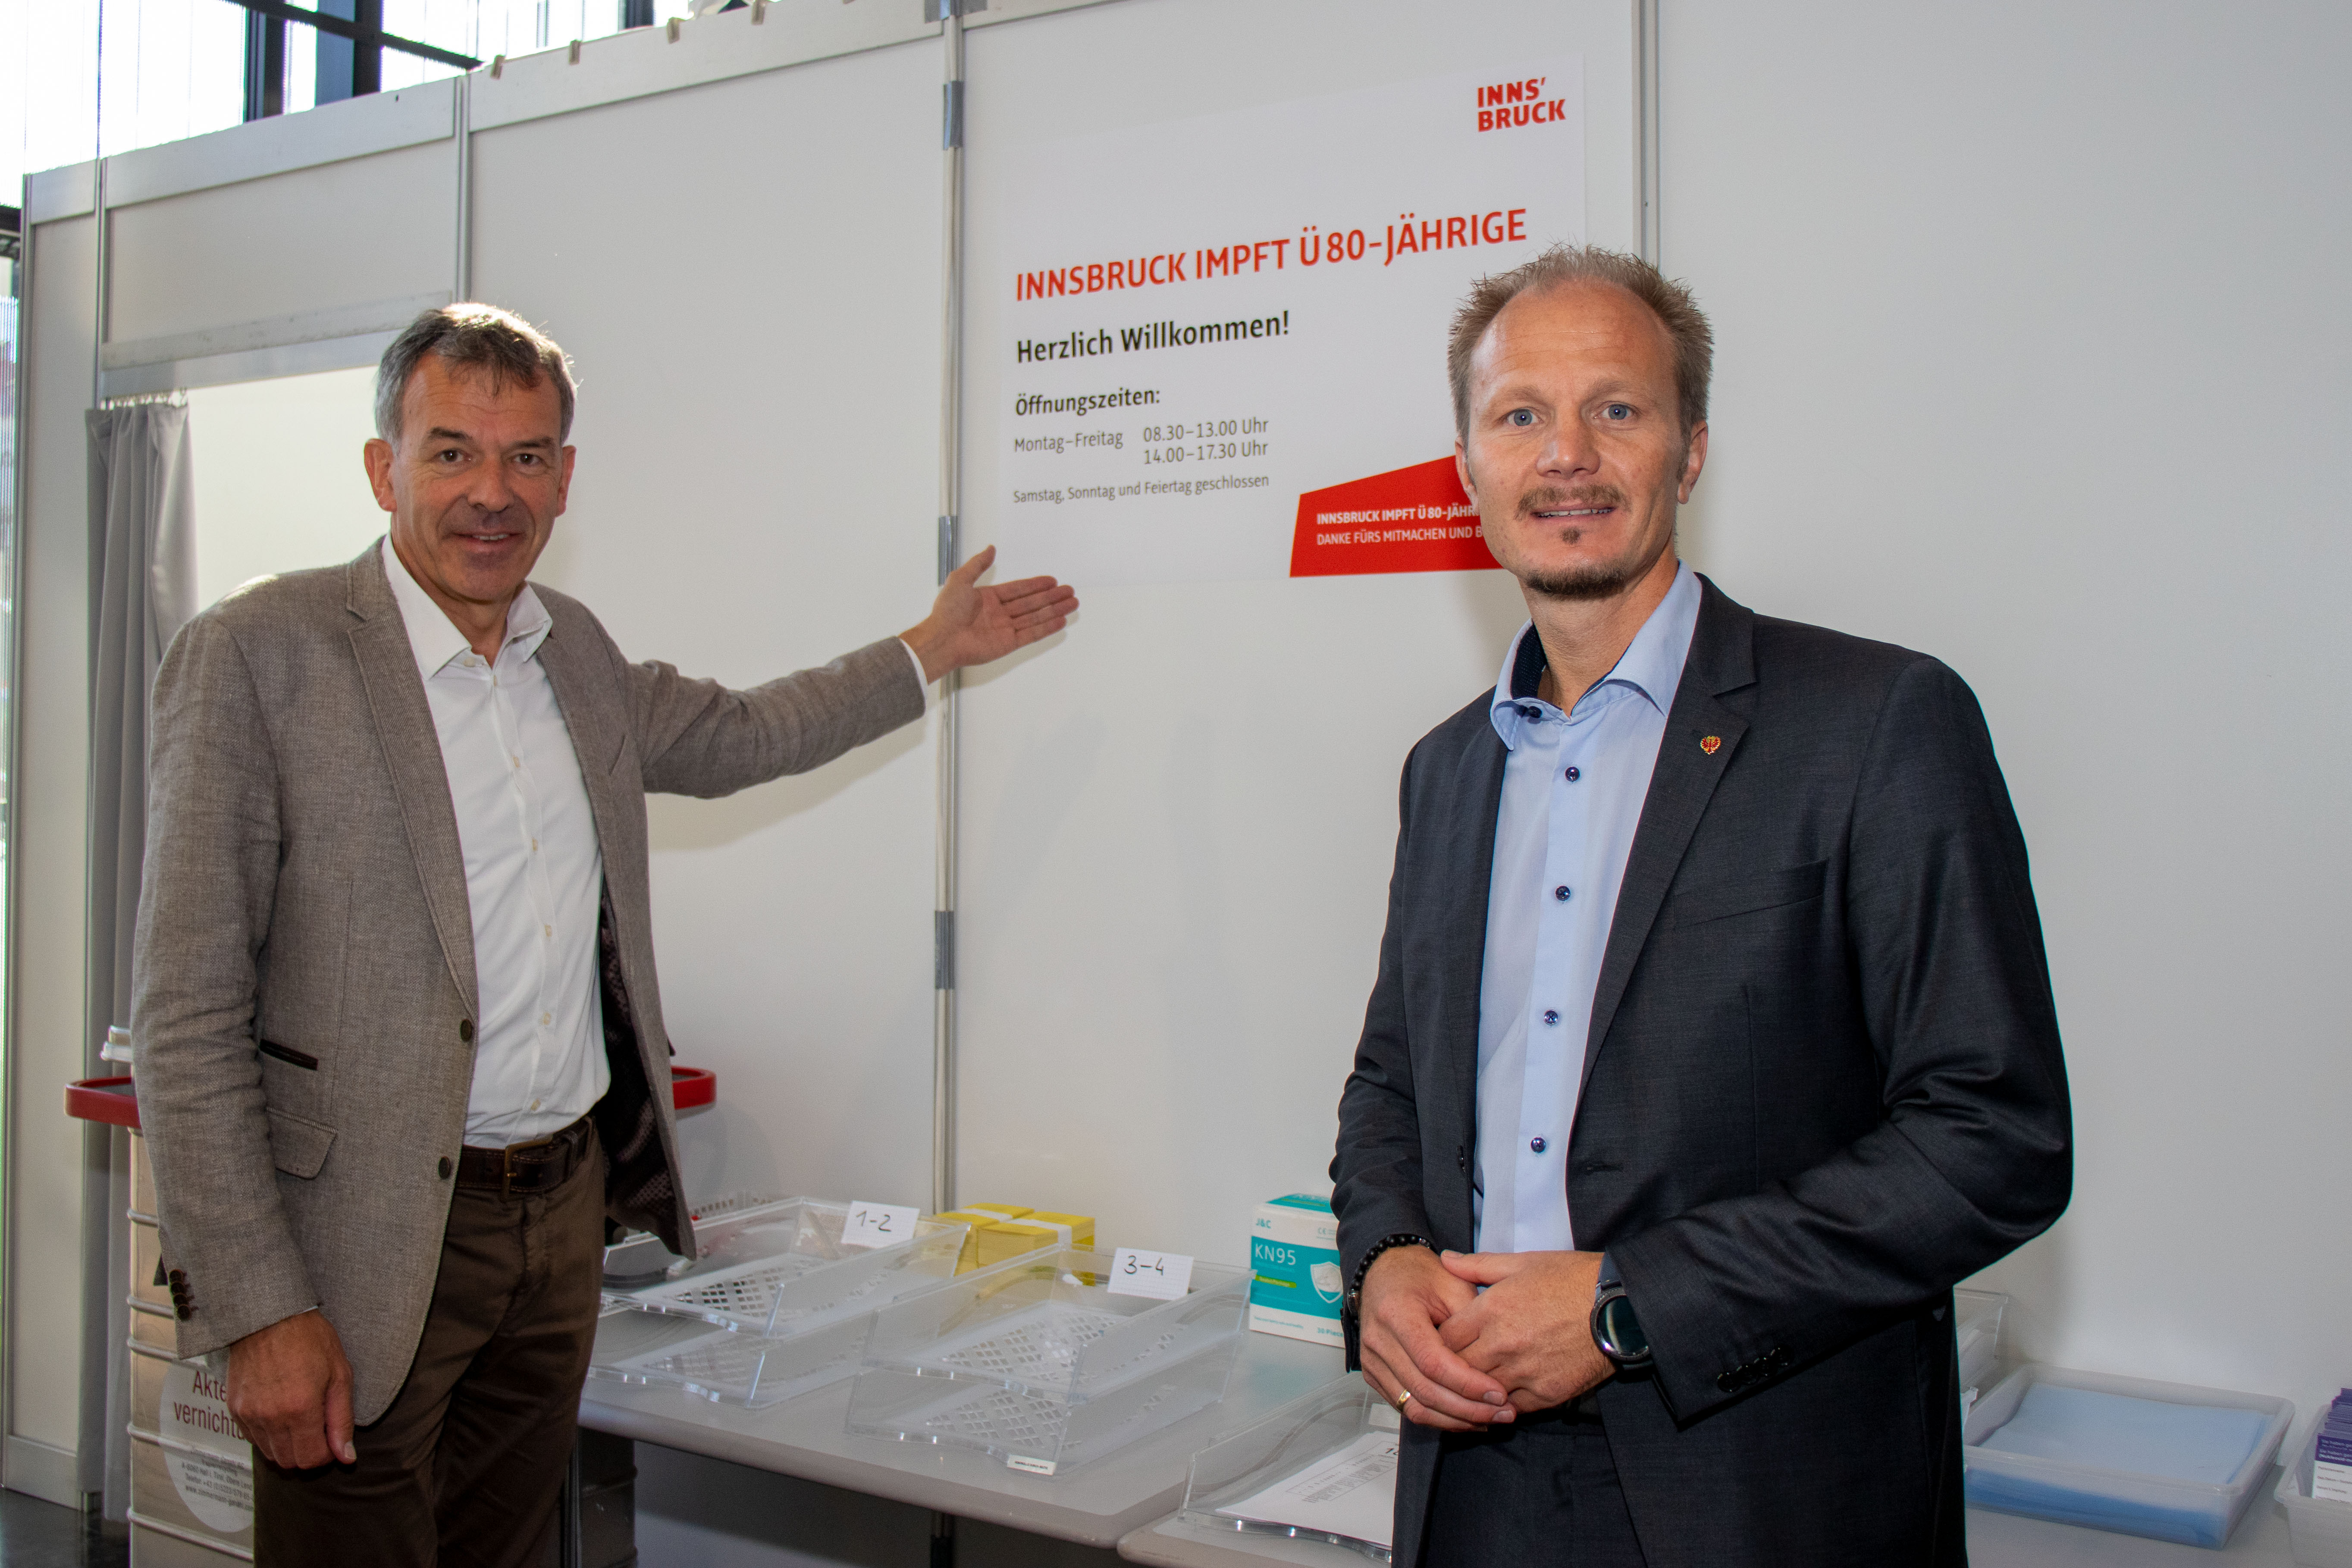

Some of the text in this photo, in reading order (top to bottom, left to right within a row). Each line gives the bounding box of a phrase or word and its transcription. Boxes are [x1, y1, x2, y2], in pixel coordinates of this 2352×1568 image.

[1478, 99, 1567, 132] BRUCK
[1016, 252, 1186, 301] INNSBRUCK
[1196, 238, 1290, 279] IMPFT
[1017, 310, 1289, 364] Herzlich Willkommen!
[1016, 387, 1160, 416] Öffnungszeiten:
[1242, 417, 1269, 435] Uhr
[1241, 439, 1268, 458] Uhr
[1013, 475, 1269, 504] Samstag, Sonntag und Feiertag geschlossen
[1317, 503, 1480, 525] INNSBRUCK IMPFT Ü80-JÄHR
[1317, 525, 1483, 546] DANKE FÜRS MITMACHEN UND B
[856, 1210, 892, 1232] 1-2
[1124, 1255, 1164, 1276] 3-4
[1255, 1243, 1296, 1266] KN95
[192, 1370, 227, 1402] Akte
